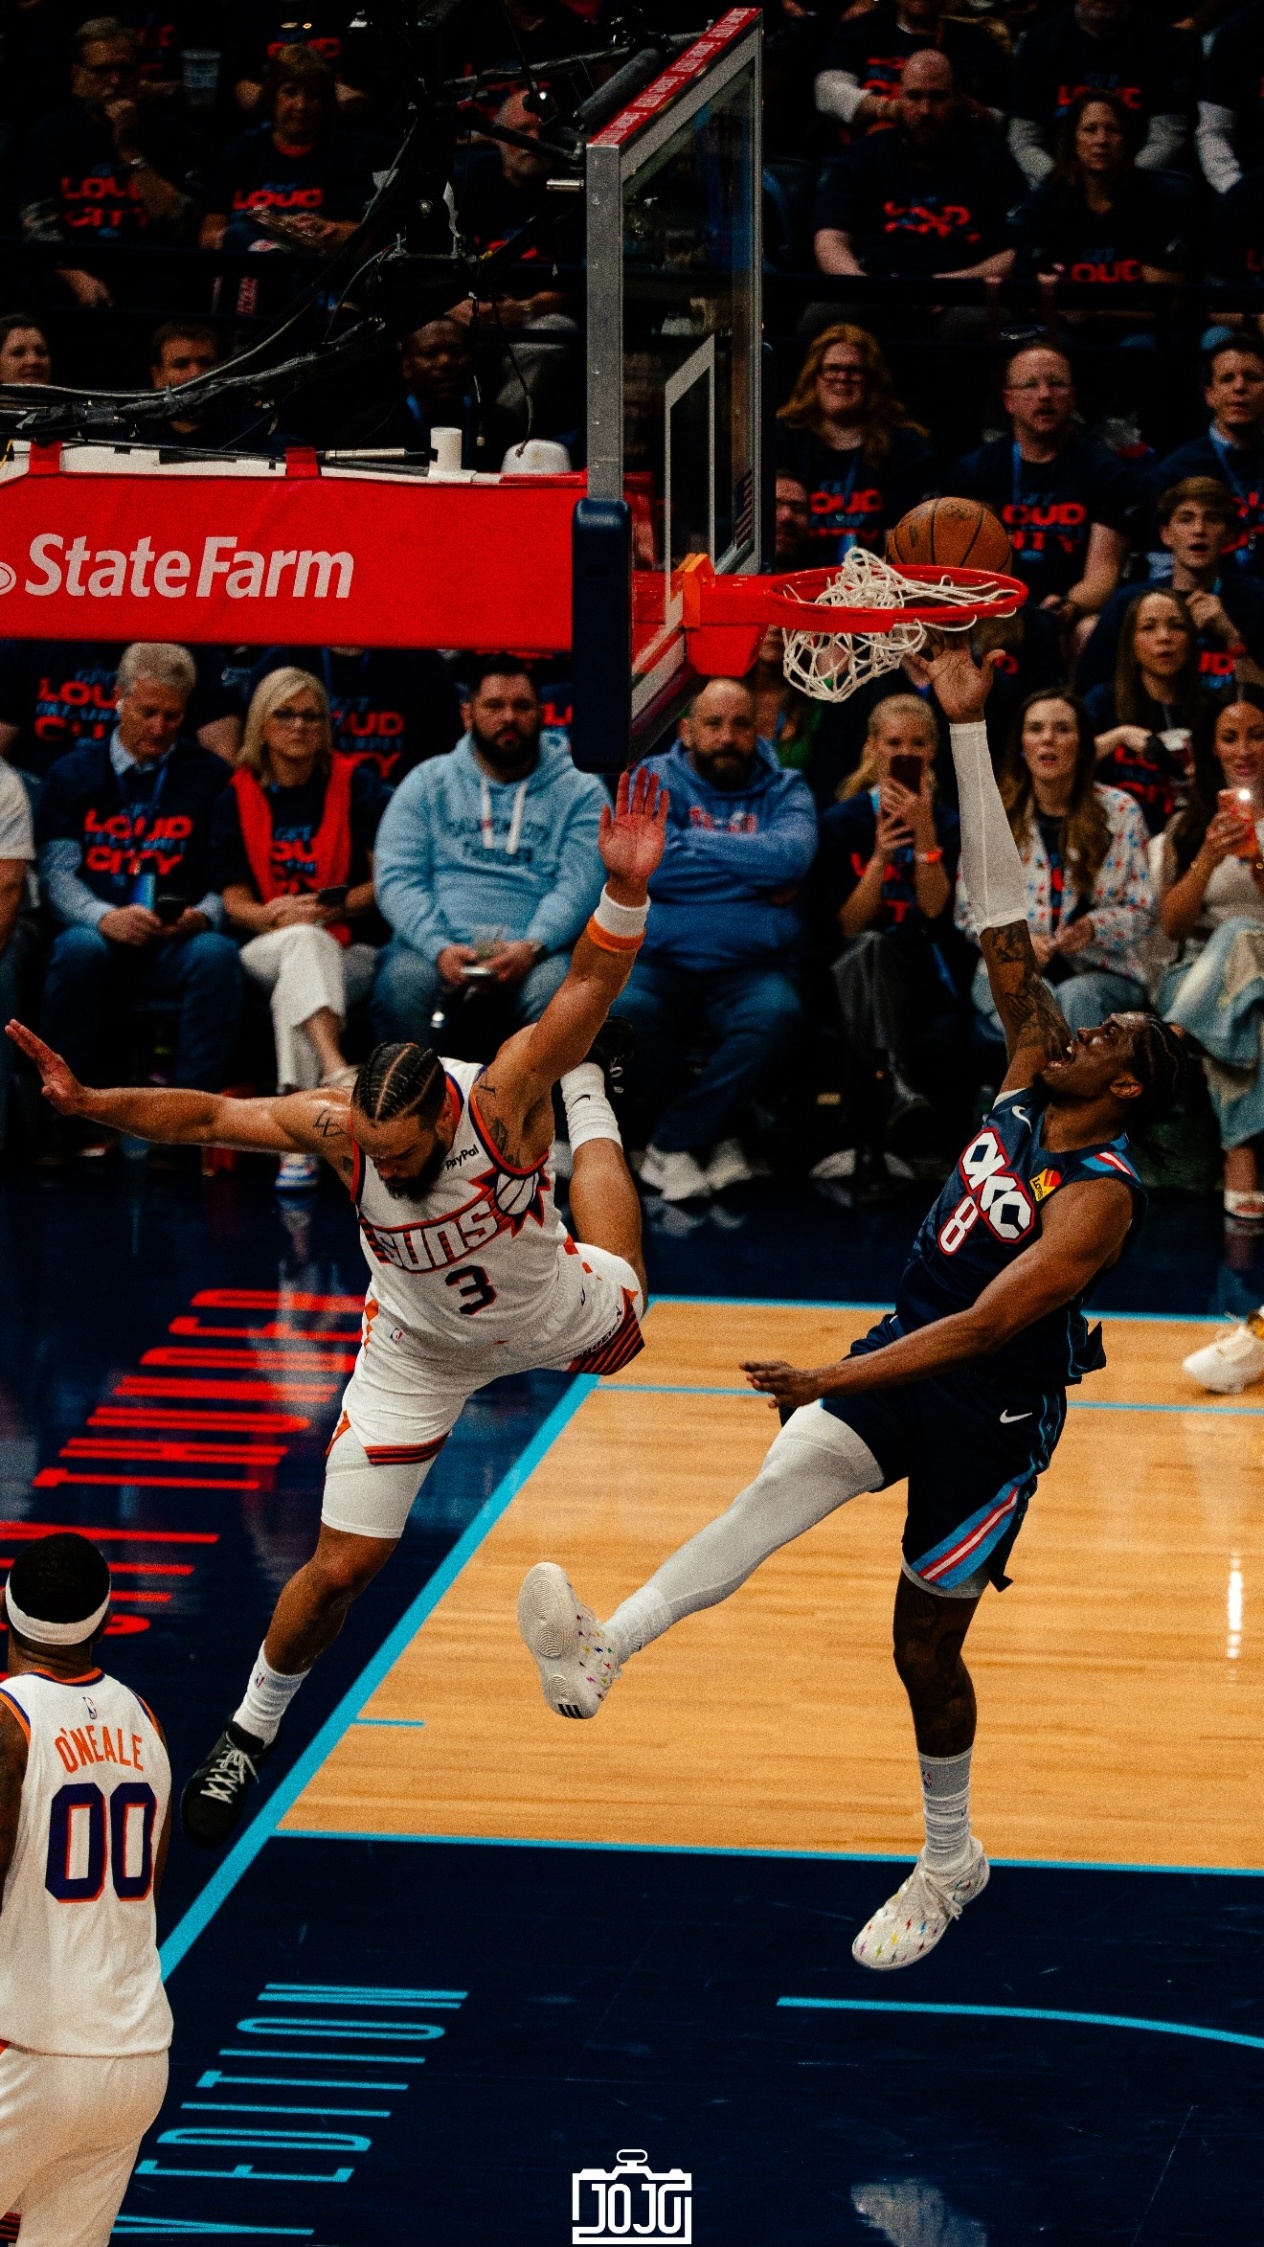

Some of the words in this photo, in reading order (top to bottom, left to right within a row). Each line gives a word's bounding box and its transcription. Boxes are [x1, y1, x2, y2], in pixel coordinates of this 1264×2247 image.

[231, 187, 326, 212] LOUD
[1069, 257, 1143, 284] OUD
[808, 486, 885, 515] OUD
[1001, 501, 1089, 527] OUD
[36, 676, 119, 709] LOU
[83, 806, 195, 842] LOUD
[85, 843, 185, 877] CITY
[445, 1143, 480, 1171] PayPal
[960, 1129, 1034, 1242] OKC
[371, 1201, 500, 1271] SUNS
[938, 1195, 980, 1254] 8
[444, 1264, 497, 1316] 3
[54, 1723, 144, 1774] O'NEALE
[45, 1781, 157, 1904] 00
[133, 1981, 470, 2184] EDITION
